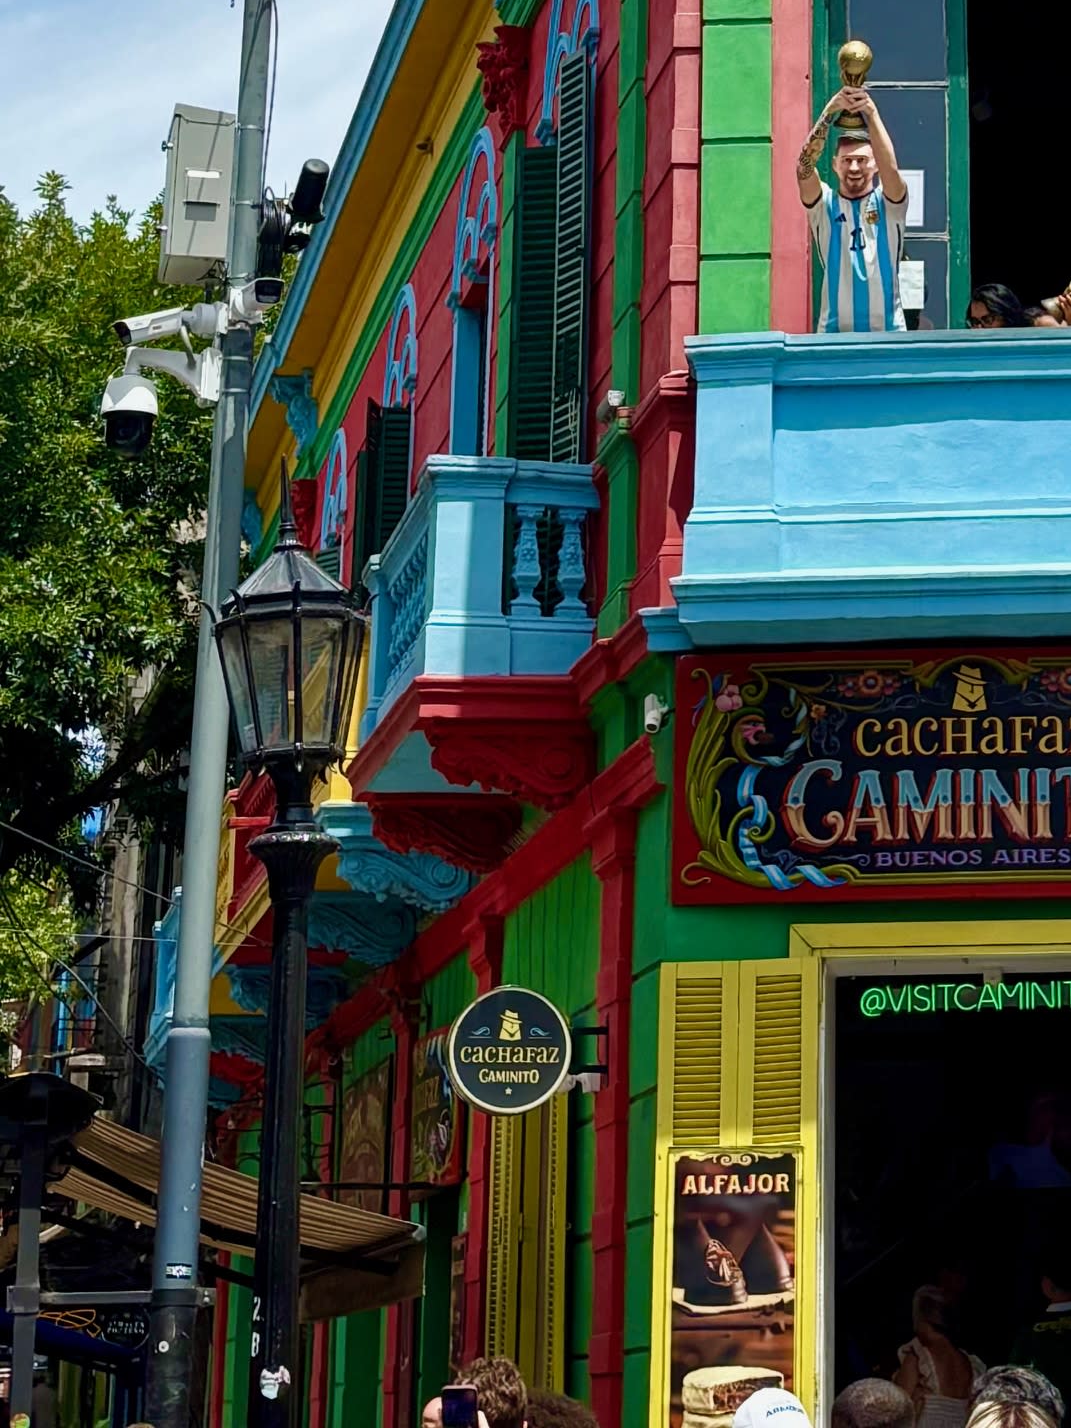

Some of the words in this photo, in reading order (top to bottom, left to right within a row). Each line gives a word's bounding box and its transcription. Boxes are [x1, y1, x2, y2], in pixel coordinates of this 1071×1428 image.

[875, 848, 983, 867] BUENOS
[991, 847, 1071, 866] AIRES
[478, 1068, 540, 1084] CAMINITO
[680, 1173, 790, 1195] ALFAJOR
